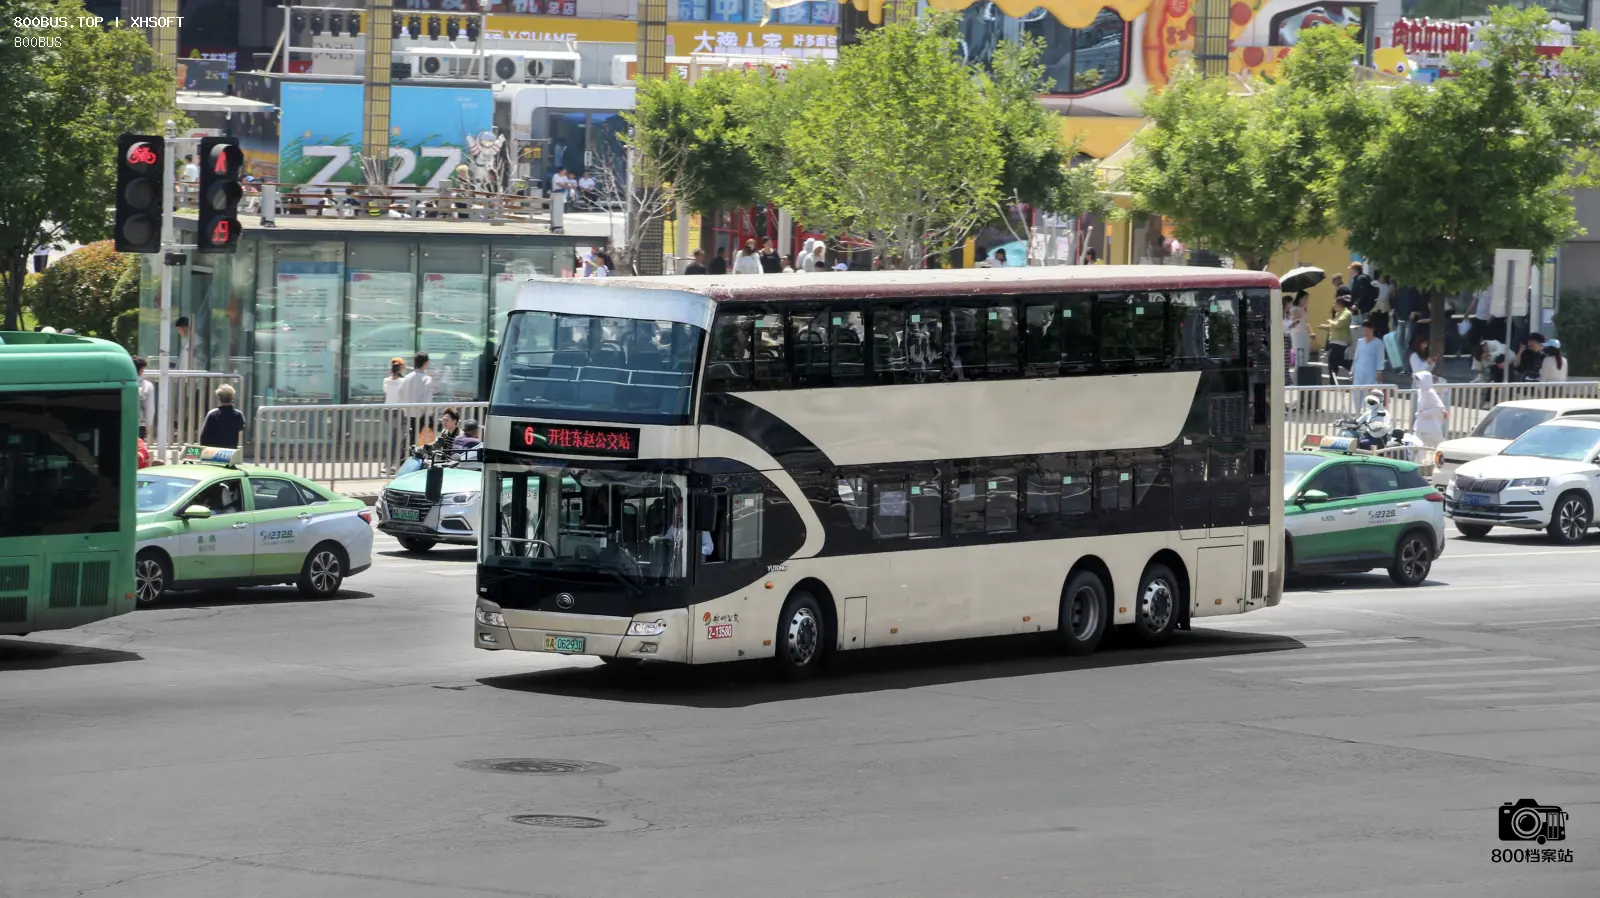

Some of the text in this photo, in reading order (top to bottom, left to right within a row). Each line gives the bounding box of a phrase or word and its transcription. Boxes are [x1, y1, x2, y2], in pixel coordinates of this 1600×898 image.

[793, 34, 838, 48] 好多面包
[524, 425, 631, 450] 6 开往东赵公交站
[708, 625, 732, 639] 2-13580
